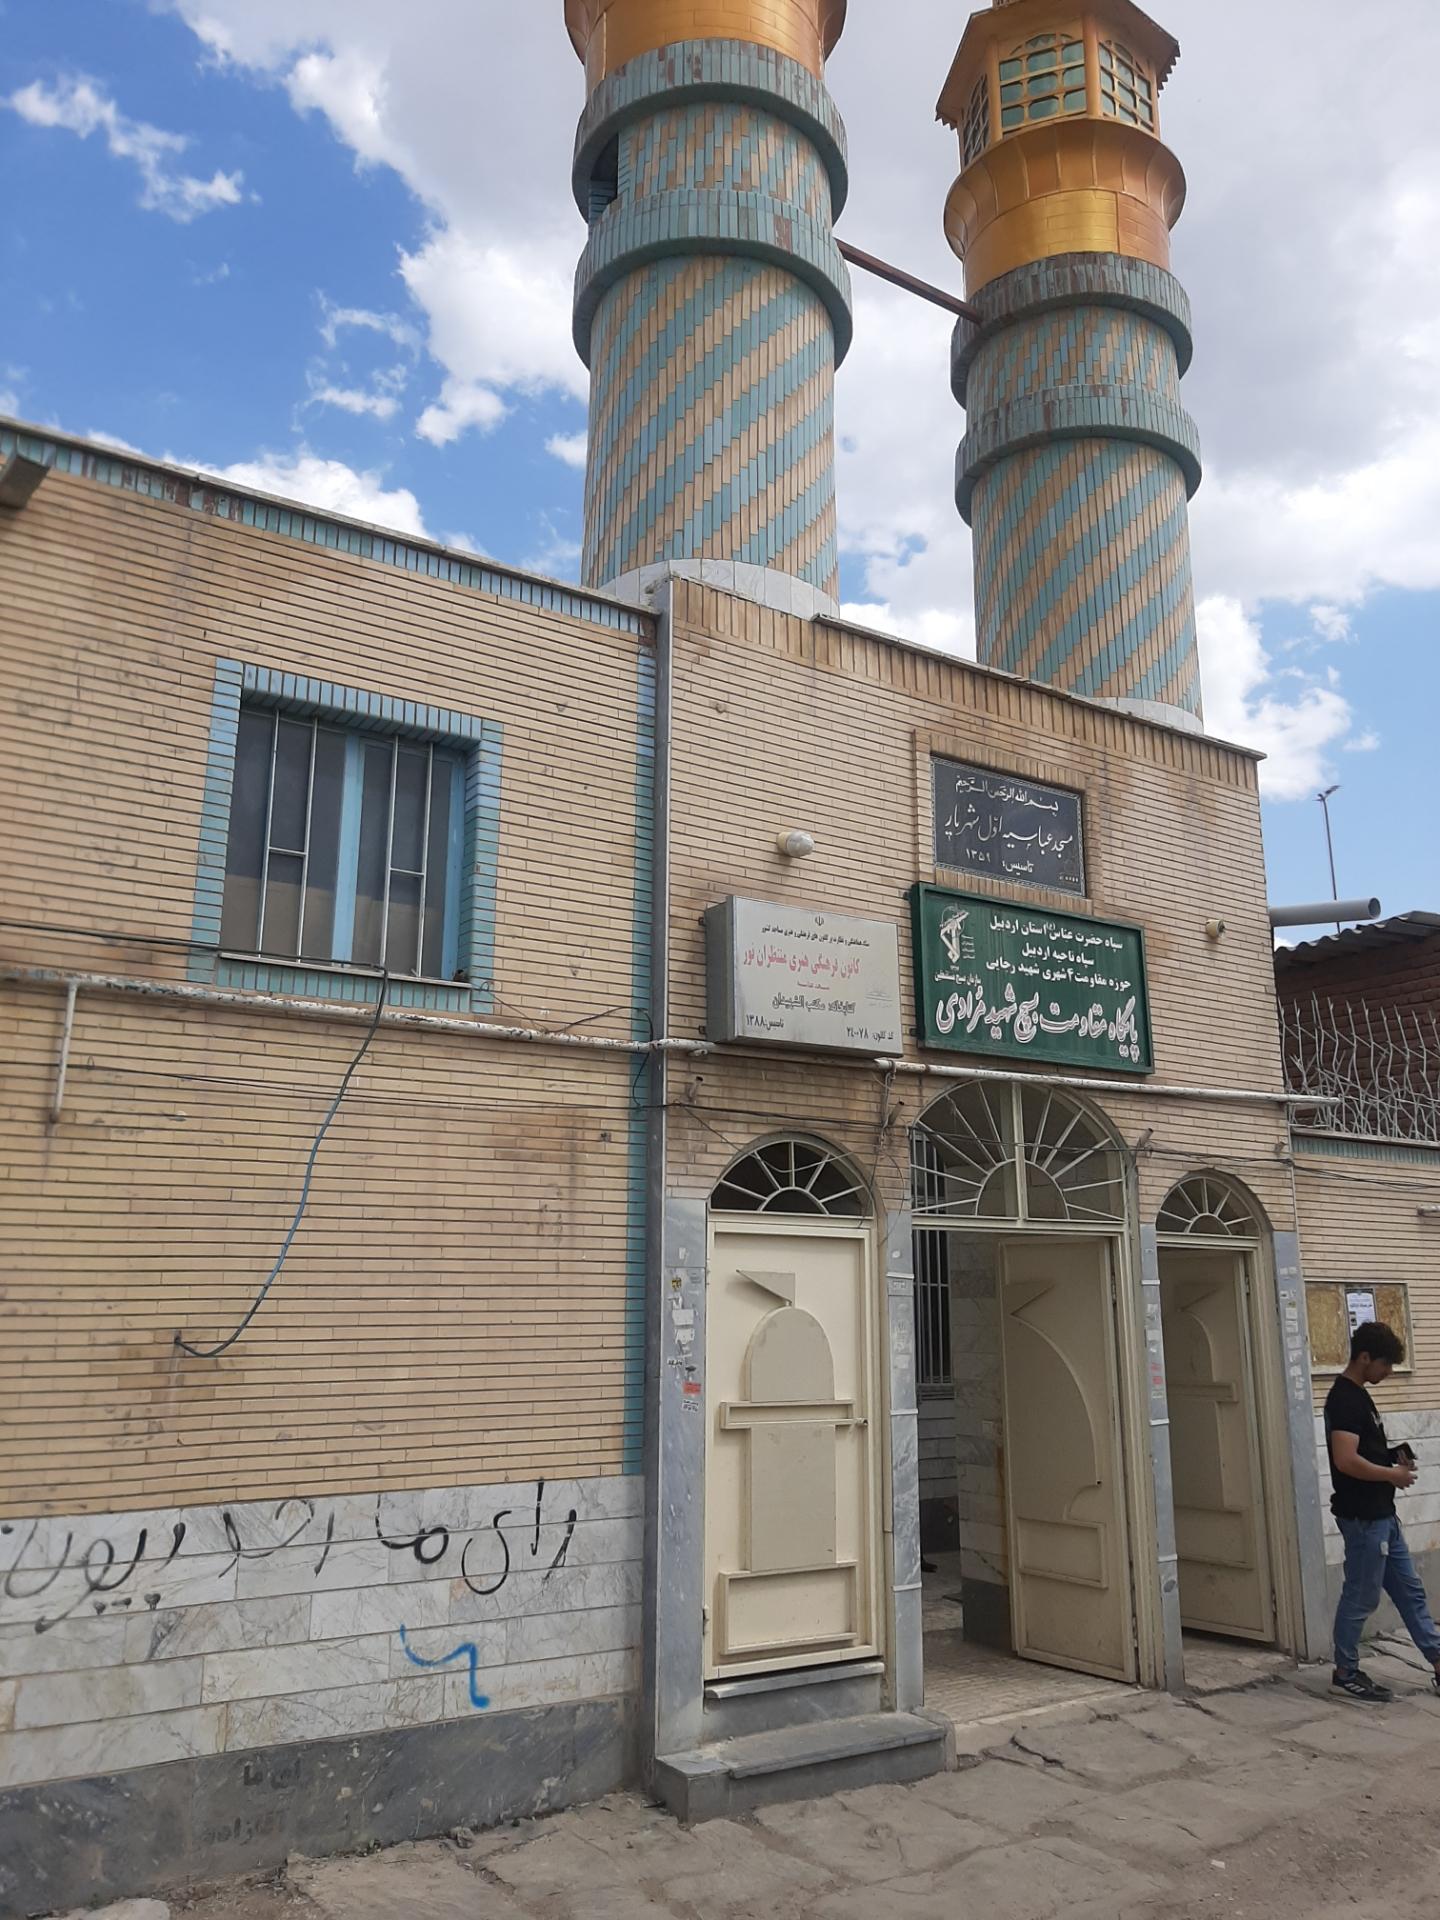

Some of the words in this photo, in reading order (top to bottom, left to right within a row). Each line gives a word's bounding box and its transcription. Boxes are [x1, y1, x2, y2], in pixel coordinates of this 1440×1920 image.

[944, 803, 980, 841] شهریار
[1002, 825, 1053, 855] عباسیه
[1051, 834, 1073, 858] مسجد
[989, 915, 1019, 934] اردبیل
[1021, 921, 1047, 935] استان
[1049, 928, 1073, 942] عباس
[1075, 932, 1103, 947] حضرت
[1104, 936, 1123, 952] سپاه
[743, 942, 755, 966] نور
[756, 944, 787, 968] منتظران
[1021, 942, 1050, 960] اردبیل
[1052, 950, 1075, 963] ناحیه
[1076, 952, 1095, 968] سپاه
[788, 951, 809, 972] هنری
[811, 953, 838, 978] فرهنگی
[840, 957, 860, 979] کانون
[985, 956, 1016, 974] رجایی
[1018, 962, 1040, 976] شهید
[1042, 967, 1067, 981] شهری
[1073, 971, 1107, 987] مقاومت
[1108, 978, 1132, 991] حوزه
[983, 982, 1018, 1040] شهید
[1013, 991, 1040, 1043] بسیج
[1039, 1001, 1108, 1039] مقاومت
[1107, 995, 1141, 1063] پایگاه
